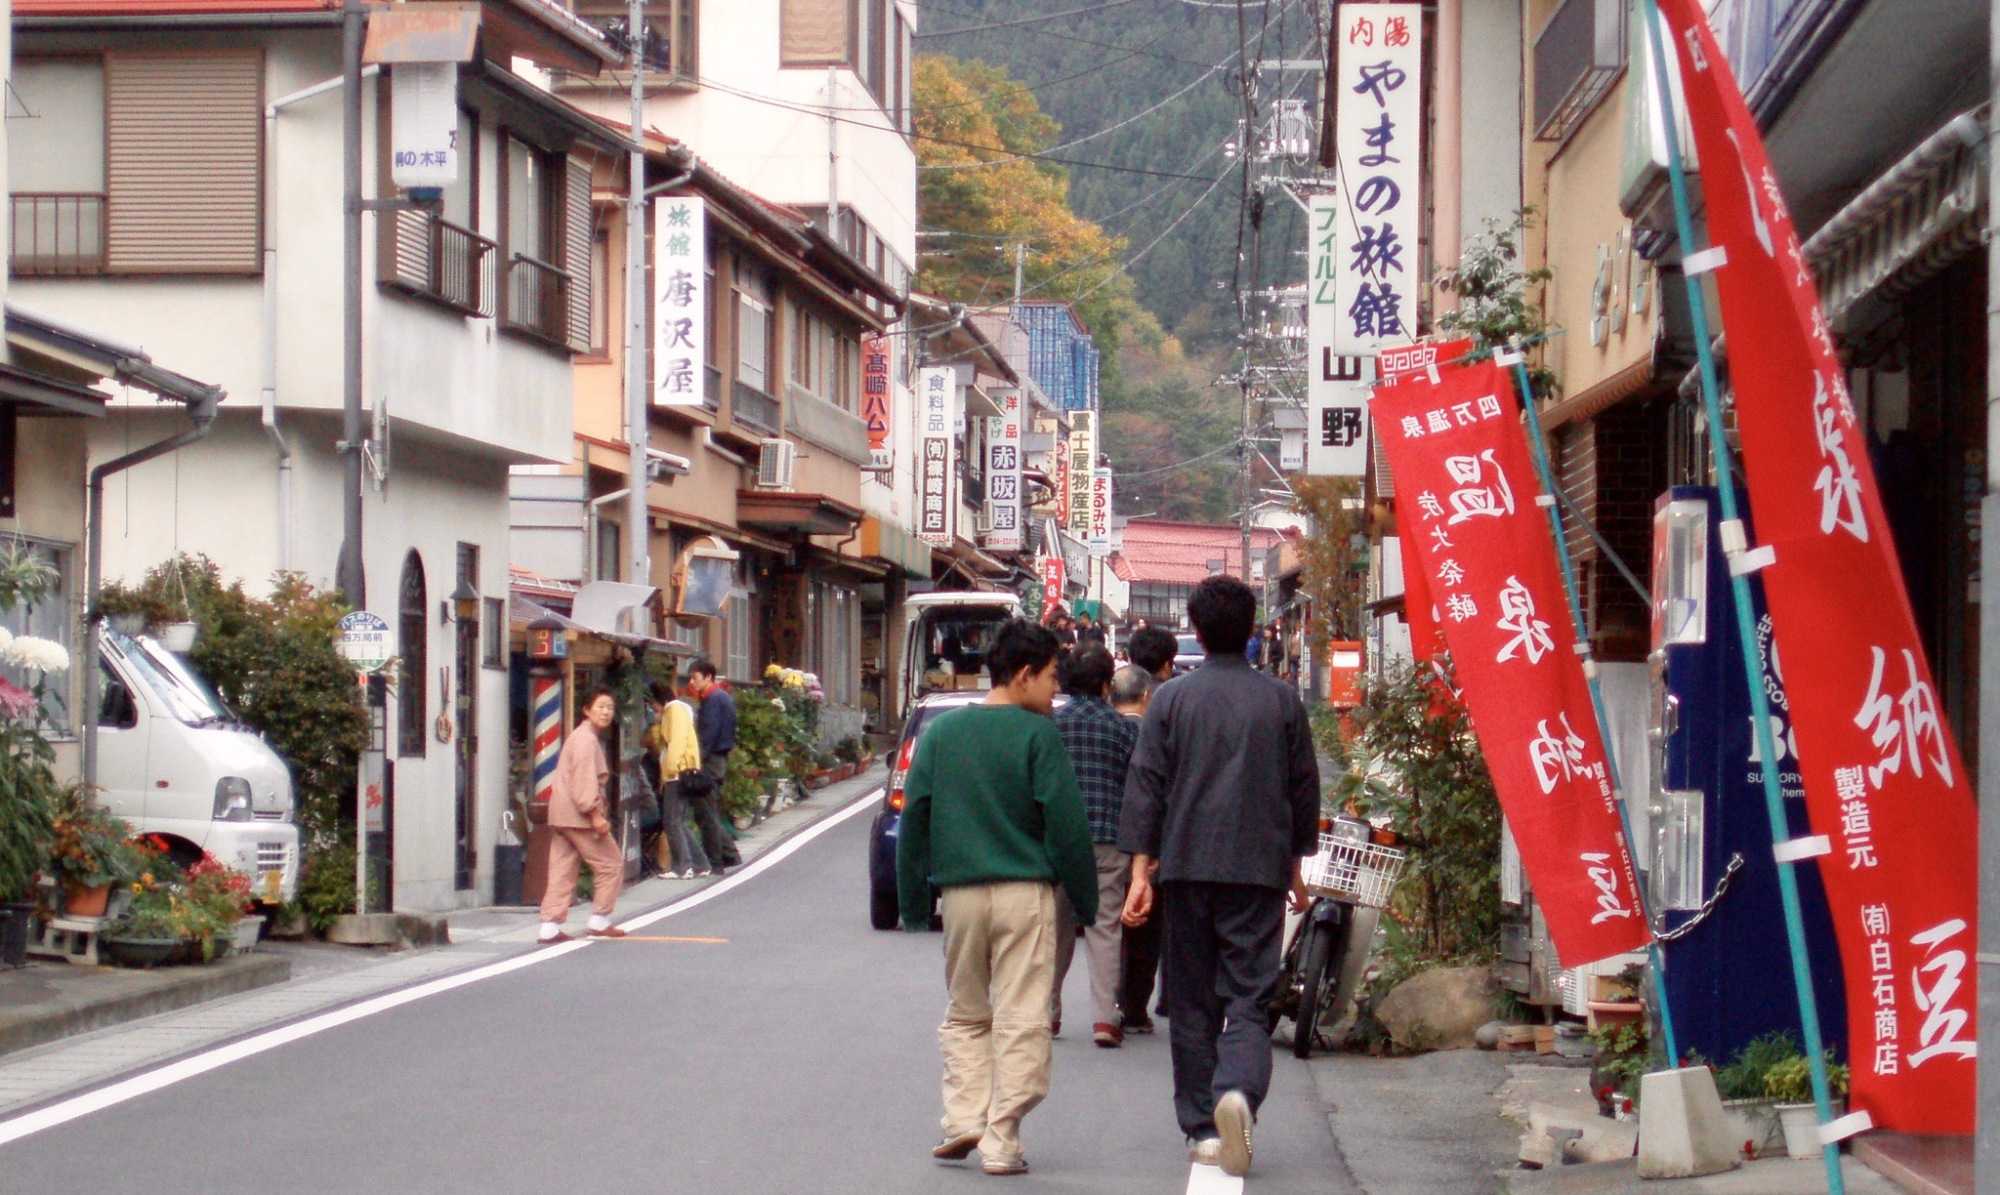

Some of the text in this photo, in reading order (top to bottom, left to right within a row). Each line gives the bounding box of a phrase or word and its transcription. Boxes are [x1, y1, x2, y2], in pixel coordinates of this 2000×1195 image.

[1349, 16, 1411, 47] 内湯
[667, 203, 691, 257] 旅館
[1348, 60, 1406, 339] やまの旅館
[660, 268, 698, 394] 唐沢屋
[928, 374, 946, 432] 食料品
[1321, 346, 1363, 447] 山野
[992, 445, 1016, 530] 赤坂屋
[1093, 477, 1107, 538] まるみや
[1747, 772, 1803, 784] SUORY
[1834, 764, 1878, 870] 製造元
